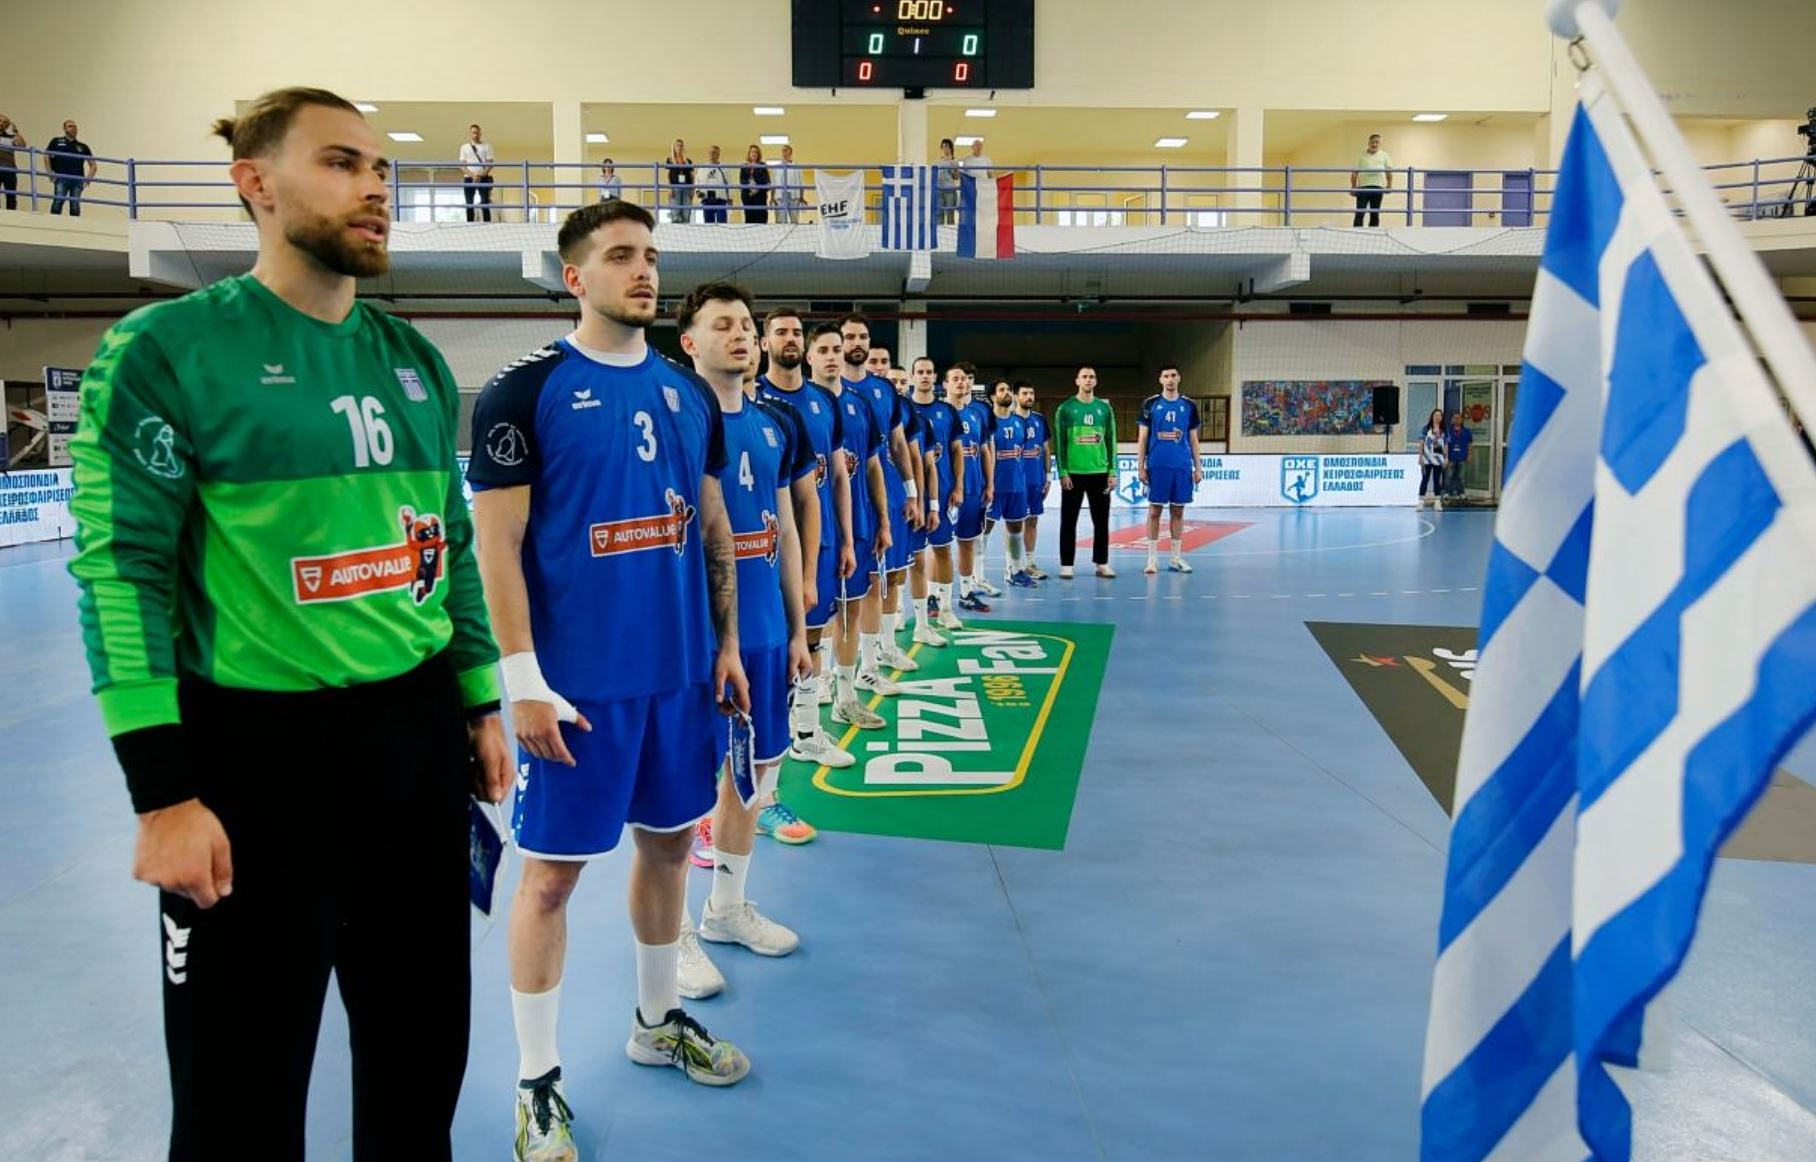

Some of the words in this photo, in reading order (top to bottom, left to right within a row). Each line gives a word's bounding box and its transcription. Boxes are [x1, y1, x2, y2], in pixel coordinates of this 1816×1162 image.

[898, 0, 943, 20] 0:00
[868, 33, 884, 55] 0
[962, 34, 978, 56] 0
[859, 62, 872, 80] 0
[955, 63, 968, 81] 0
[820, 200, 848, 216] EHF
[1083, 413, 1094, 426] 40
[1164, 410, 1177, 422] 41
[330, 395, 394, 468] 16
[633, 410, 657, 462] 3
[739, 451, 754, 492] 4
[981, 675, 1028, 701] 1996
